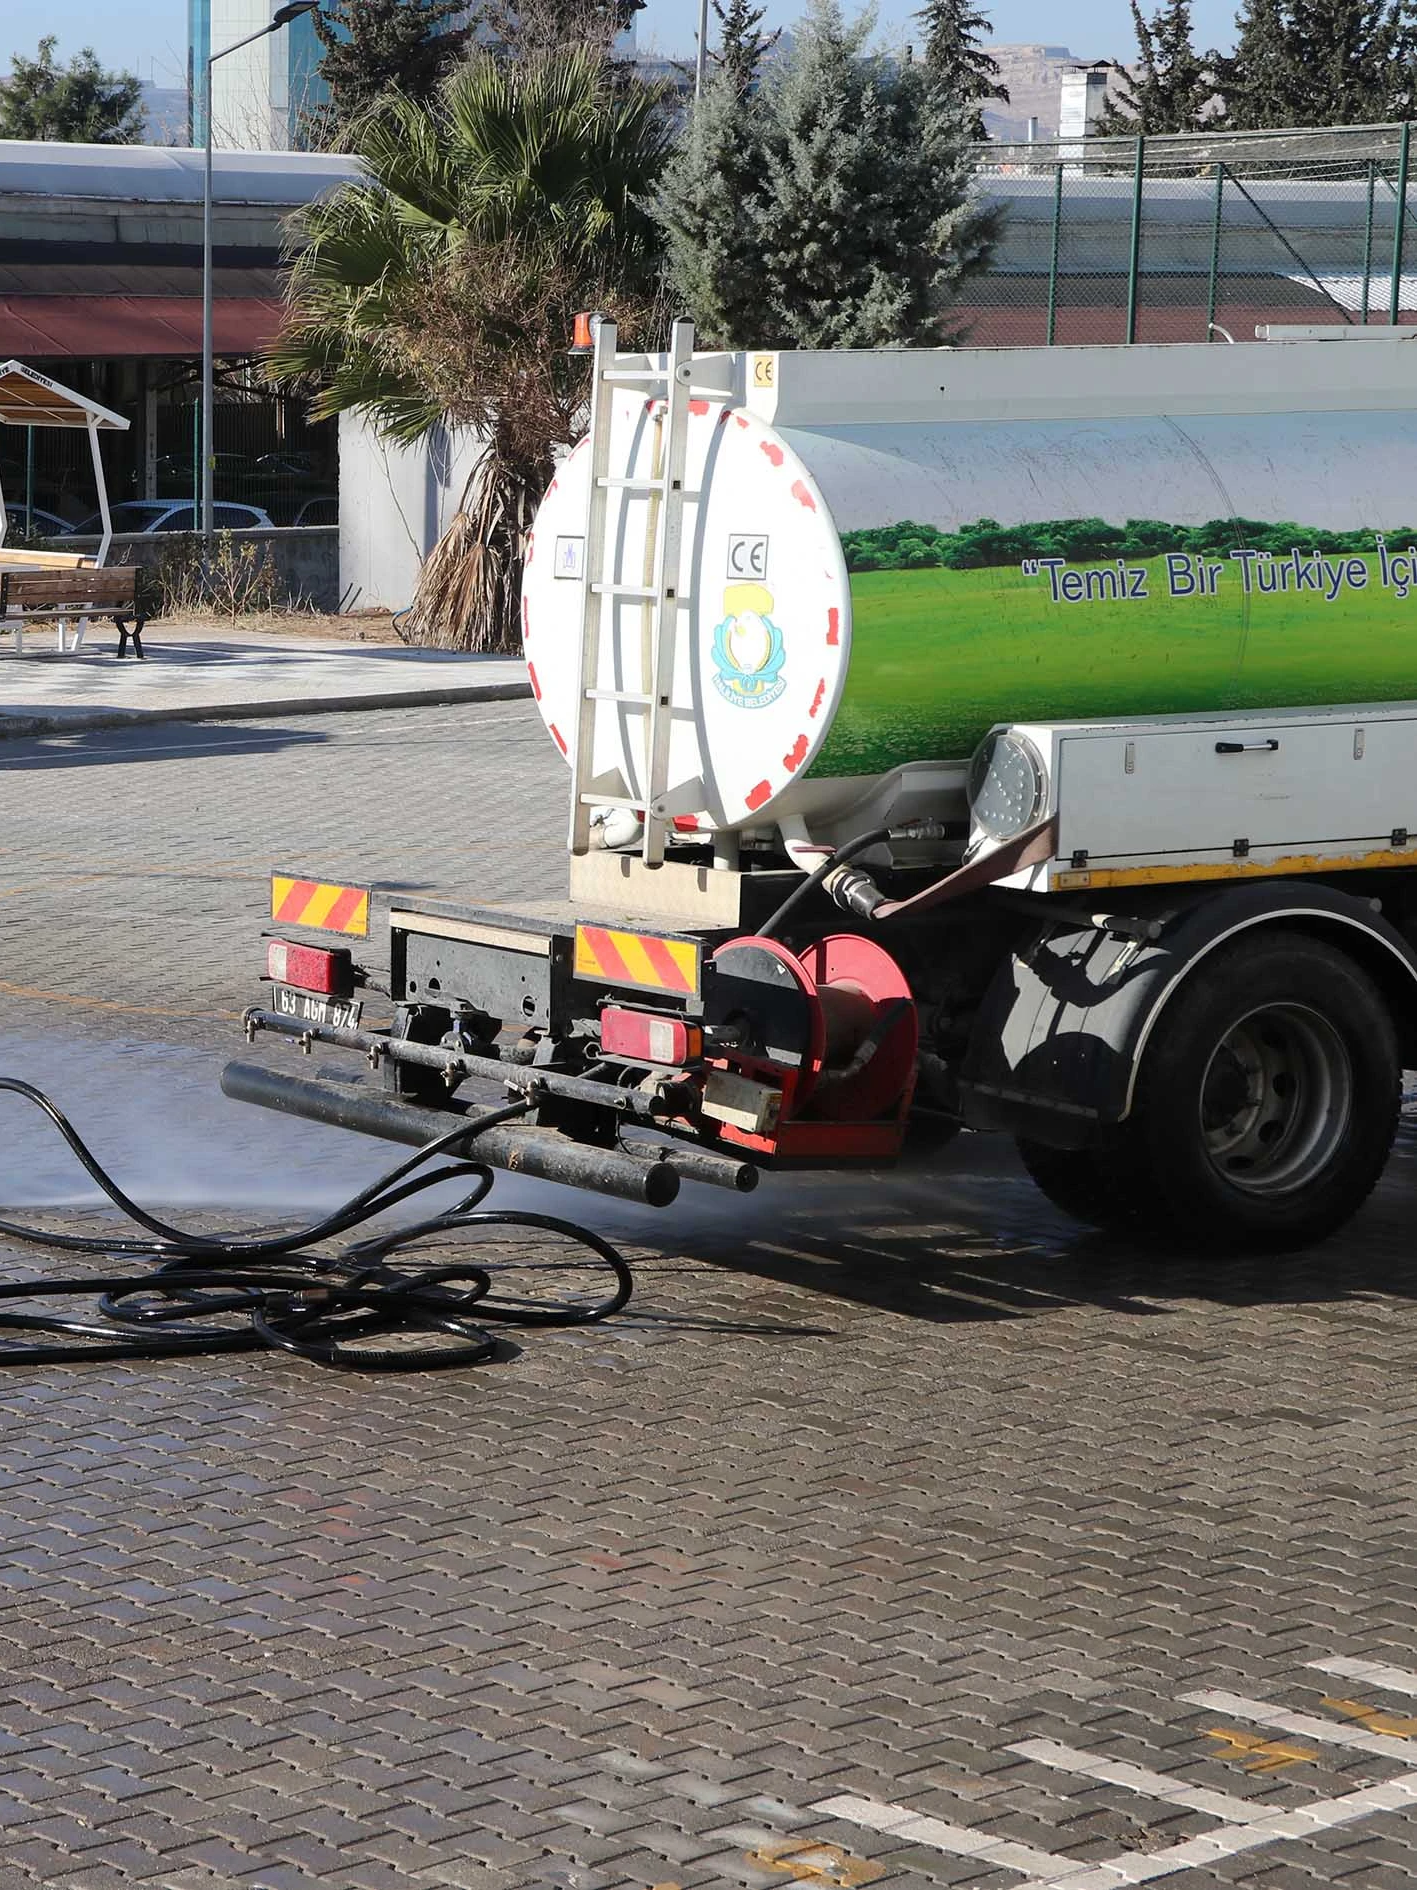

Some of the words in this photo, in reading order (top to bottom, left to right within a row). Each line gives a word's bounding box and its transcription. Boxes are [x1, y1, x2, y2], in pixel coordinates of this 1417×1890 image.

[1166, 553, 1223, 596] Bir
[1230, 548, 1367, 601] Türkiye
[281, 990, 296, 1015] 63
[303, 998, 327, 1023] AGM
